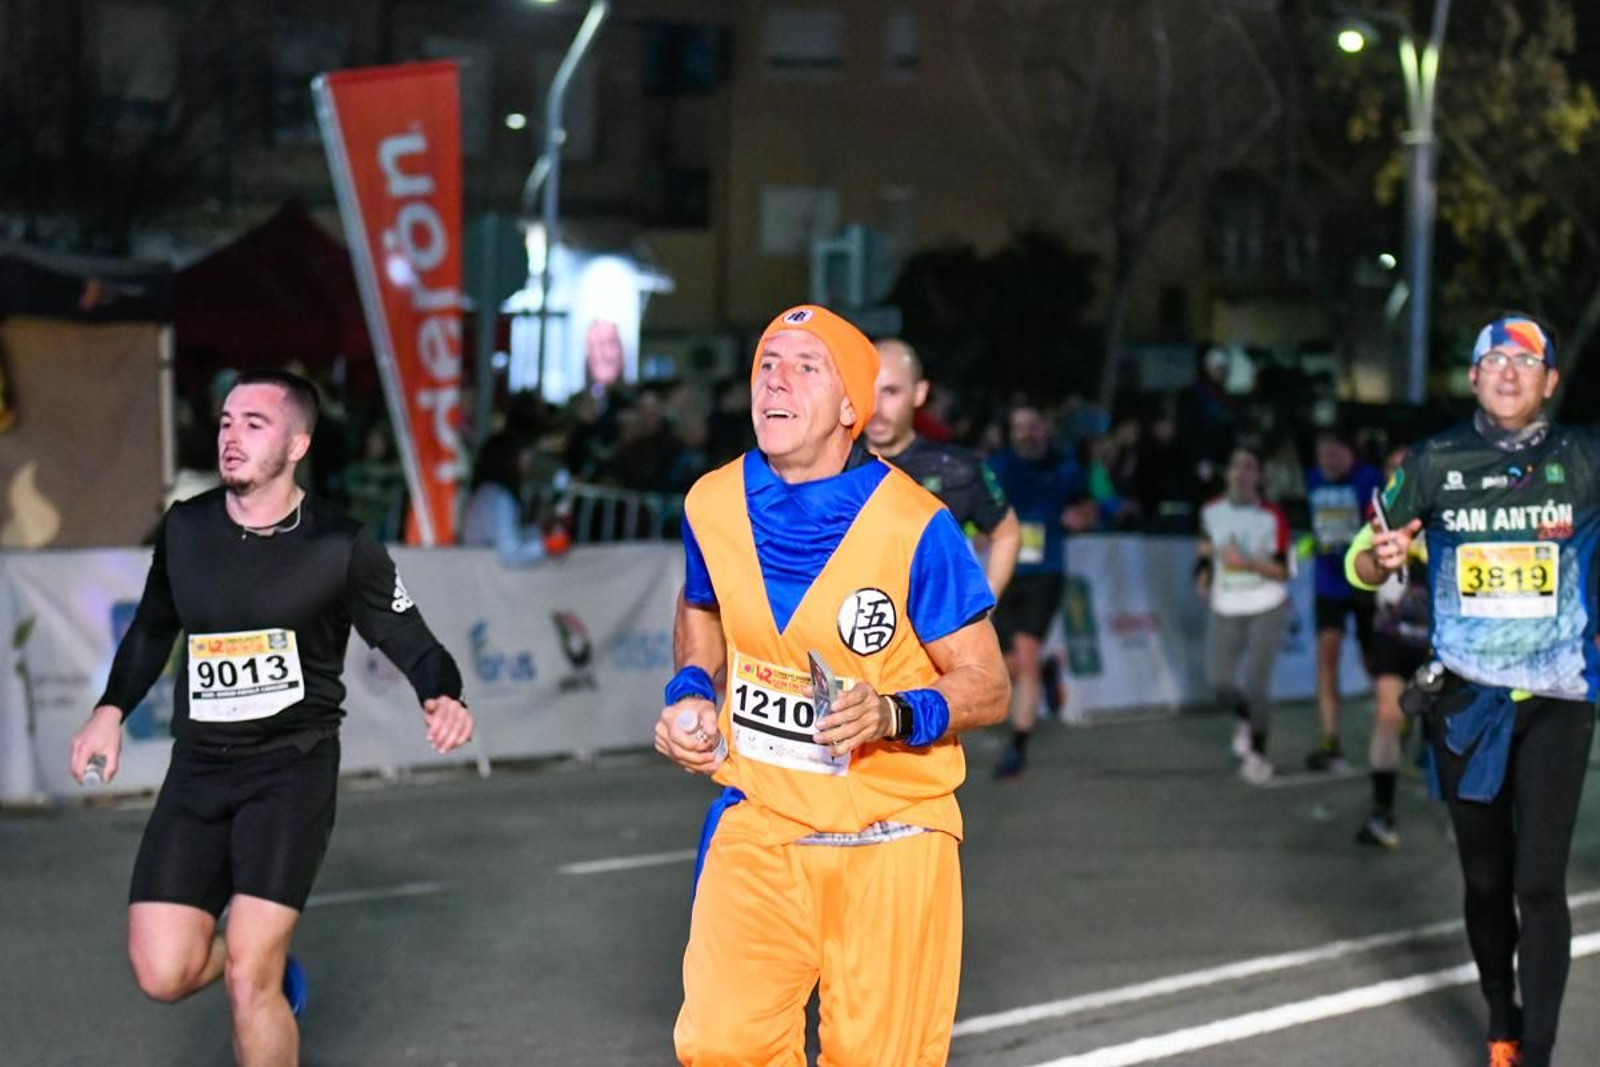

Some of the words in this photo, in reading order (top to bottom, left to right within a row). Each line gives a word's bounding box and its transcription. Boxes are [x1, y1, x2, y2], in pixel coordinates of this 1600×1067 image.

[1442, 508, 1487, 532] SAN
[1493, 499, 1573, 531] ANTÓN
[1467, 564, 1548, 590] 3819
[848, 595, 894, 649] 悟
[197, 655, 289, 689] 9013
[735, 684, 815, 729] 1210
